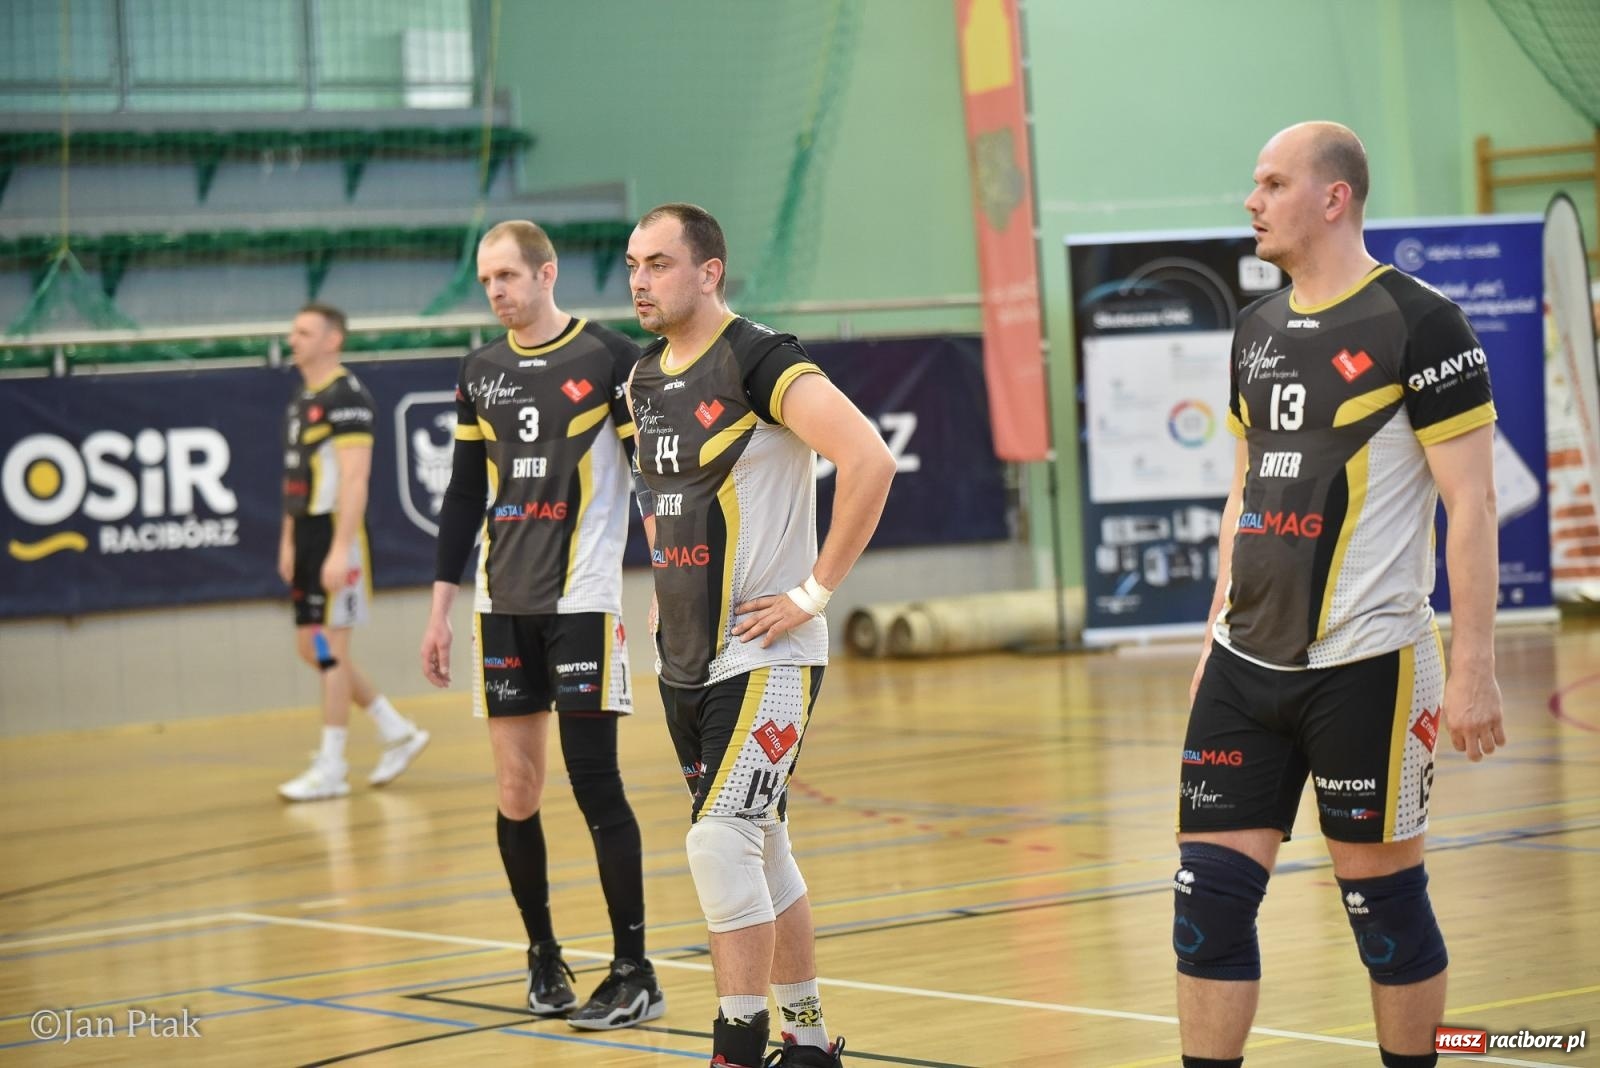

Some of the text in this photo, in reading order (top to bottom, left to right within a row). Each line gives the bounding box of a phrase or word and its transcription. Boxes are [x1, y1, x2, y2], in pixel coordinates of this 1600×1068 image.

[518, 406, 540, 443] 3
[1270, 383, 1307, 431] 13
[512, 457, 548, 479] ENTER
[654, 434, 680, 475] 14
[1259, 452, 1303, 478] ENTER
[100, 514, 239, 553] RACIBÓRZ
[764, 726, 783, 752] Enter
[743, 769, 779, 808] 14
